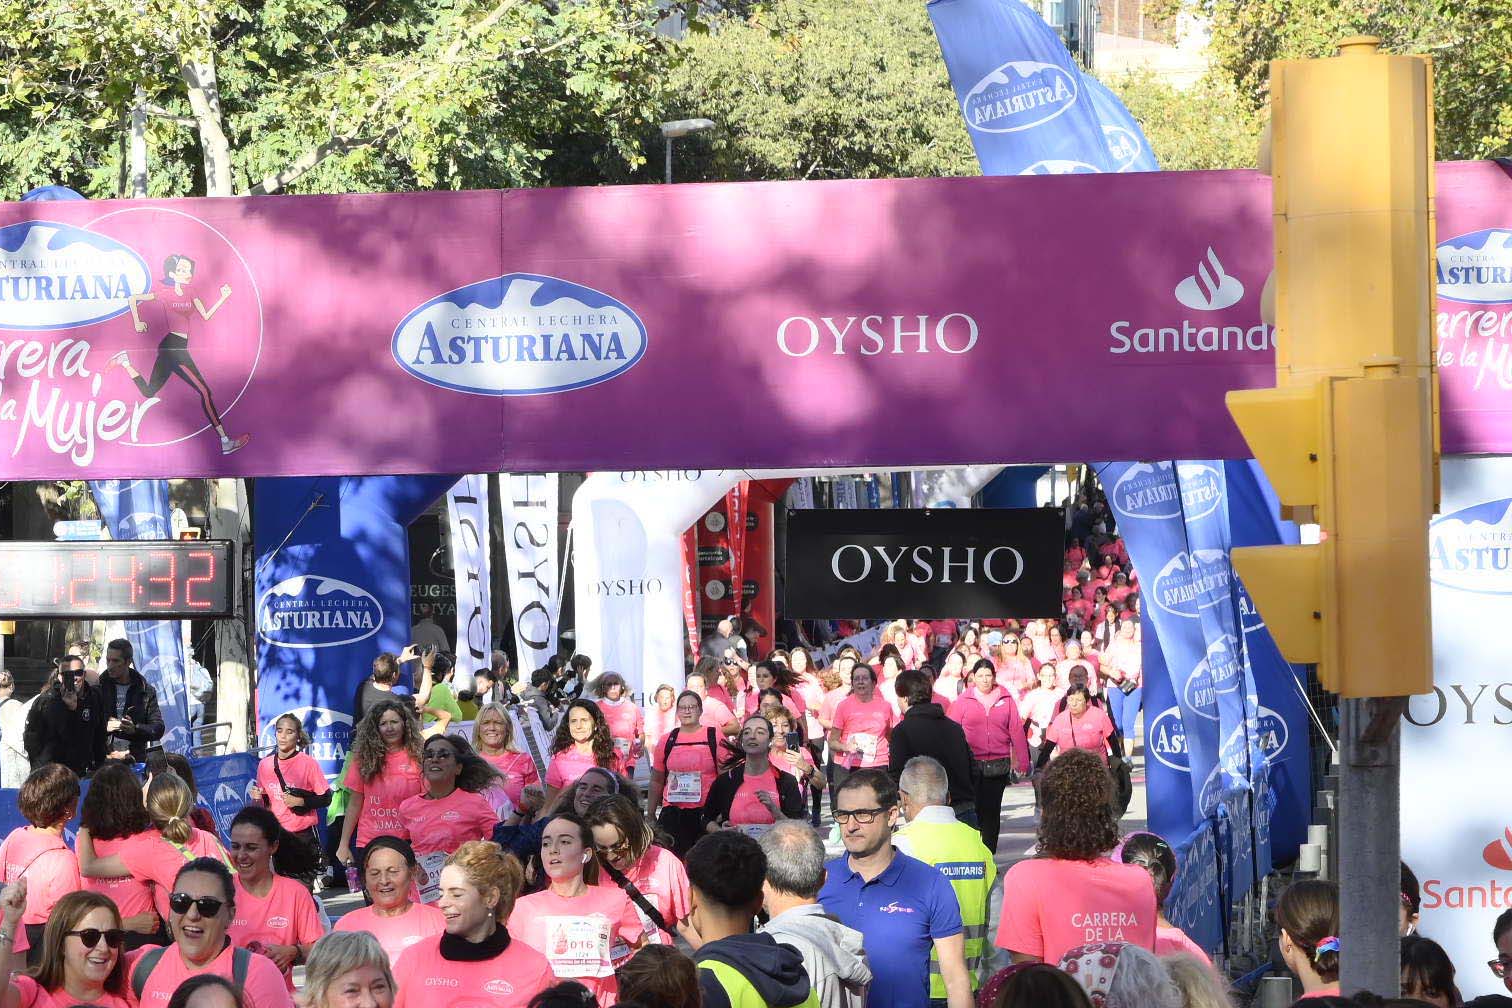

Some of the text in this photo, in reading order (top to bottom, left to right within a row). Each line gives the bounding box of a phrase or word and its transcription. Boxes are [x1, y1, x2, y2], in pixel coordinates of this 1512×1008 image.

[451, 313, 619, 329] CENTRAL LECHERA
[776, 313, 979, 357] OYSHO
[1109, 319, 1277, 354] Santand
[412, 320, 627, 365] ASTURIANA
[12, 372, 161, 467] Mujer
[831, 544, 1025, 587] OYSHO
[1430, 536, 1512, 571] ASTU
[587, 578, 662, 597] OYSHO
[261, 605, 375, 632] ASTURIANA
[1072, 912, 1138, 927] CARRERA
[1086, 927, 1124, 942] DE LA
[570, 941, 593, 949] 016
